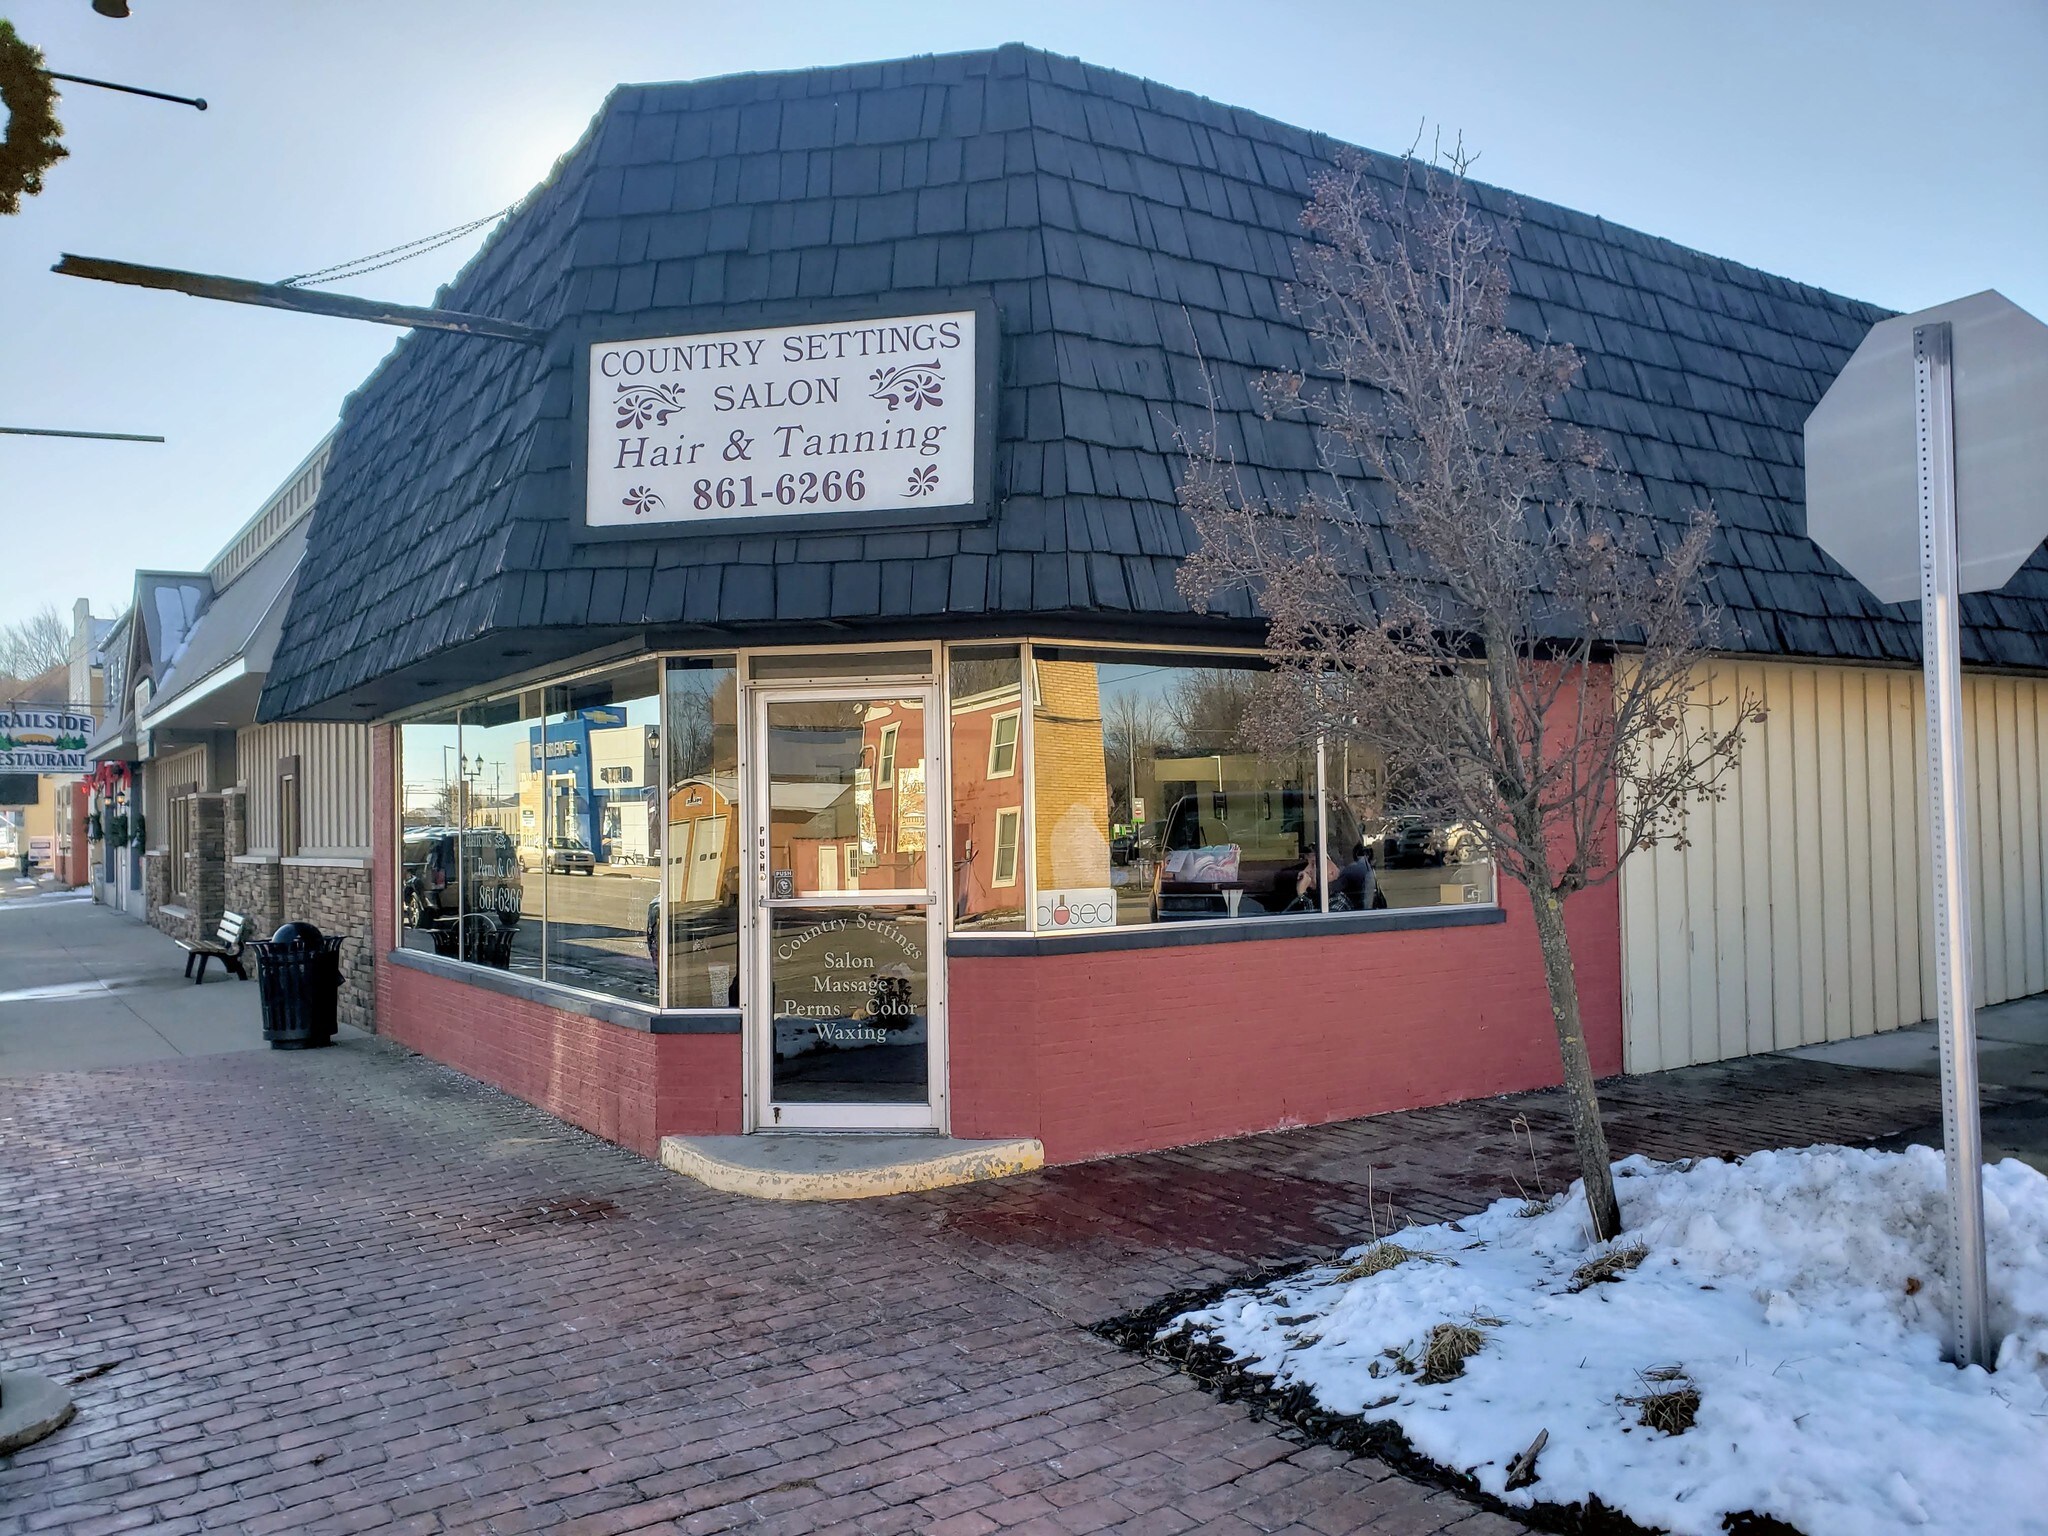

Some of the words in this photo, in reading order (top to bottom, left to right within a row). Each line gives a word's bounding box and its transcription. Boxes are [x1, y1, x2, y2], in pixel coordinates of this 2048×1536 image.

[601, 339, 766, 378] COUNTRY
[783, 321, 961, 363] SETTINGS
[713, 377, 841, 412] SALON
[614, 434, 705, 469] Hair
[722, 429, 755, 462] &
[773, 418, 947, 459] Tanning
[693, 468, 867, 511] 861-6266
[478, 857, 495, 877] Perms
[497, 857, 505, 877] &
[1037, 894, 1113, 926] closed
[778, 918, 848, 961] Country
[856, 913, 922, 960] Settings
[824, 952, 875, 969] Salon
[812, 976, 888, 995] Massage
[784, 1000, 841, 1016] Perms
[866, 999, 918, 1016] Color
[815, 1023, 887, 1043] Waxing
